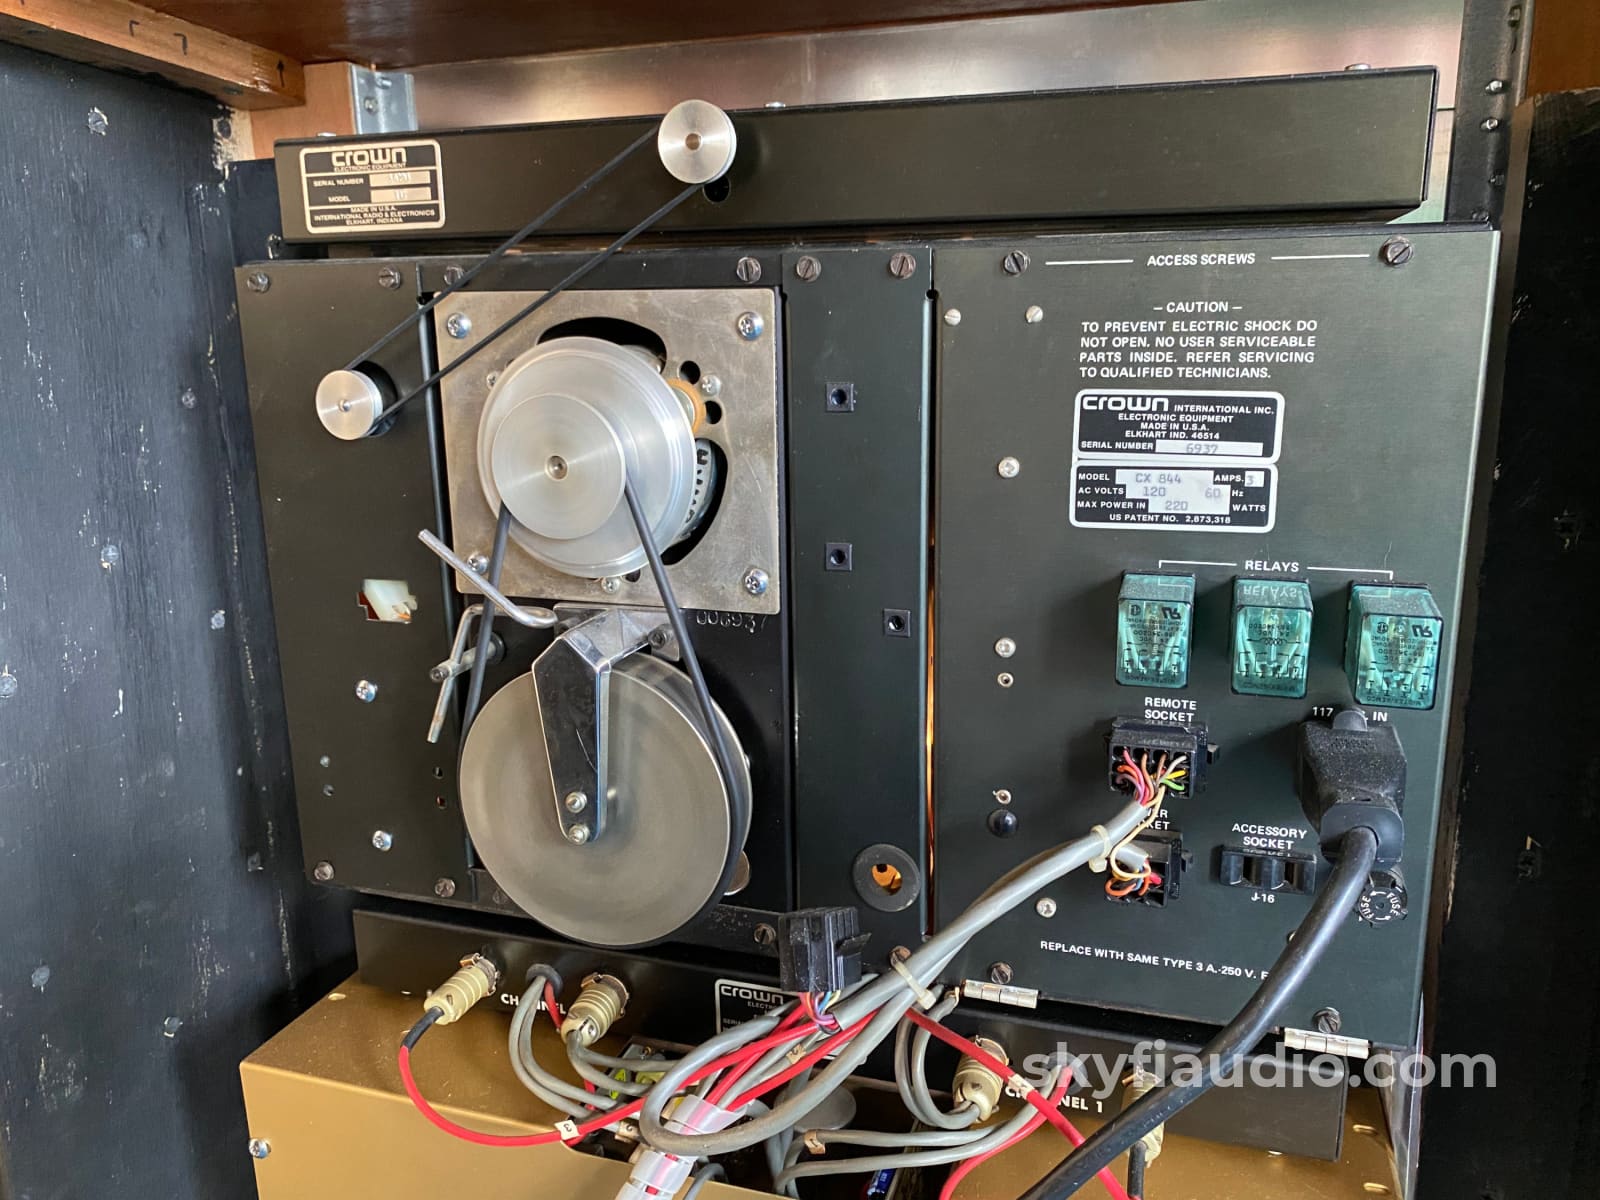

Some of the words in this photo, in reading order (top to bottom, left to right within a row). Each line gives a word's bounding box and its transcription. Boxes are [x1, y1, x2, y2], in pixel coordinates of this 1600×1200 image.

[332, 148, 407, 166] crown
[1147, 254, 1198, 267] ACCESS
[1201, 253, 1255, 265] SCREWS
[1081, 322, 1099, 333] TO
[1104, 321, 1166, 333] PREVENT
[1172, 321, 1239, 332] ELECTRIC
[1244, 320, 1292, 332] SHOCK
[1296, 320, 1318, 331] DO
[1080, 336, 1108, 348] NOT
[1112, 336, 1150, 348] OPEN.
[1155, 336, 1174, 348] NO
[1179, 336, 1214, 348] USER
[1219, 336, 1316, 348] SERVICEABLE
[1079, 352, 1122, 363] PARTS
[1129, 352, 1177, 363] INSIDE.
[1186, 352, 1231, 363] REFER
[1238, 351, 1314, 363] SERVICING
[1079, 367, 1097, 378] TO
[1100, 367, 1173, 378] QUALIFIED
[1177, 367, 1271, 379] TECHNICIANS.
[1082, 396, 1169, 411] crown
[1174, 405, 1252, 414] INTERNATIONAL
[1254, 406, 1274, 414] INC.
[1118, 413, 1177, 421] ELECTRONIC
[1115, 442, 1153, 450] NUMBER
[1186, 443, 1219, 454] 6937
[1135, 473, 1153, 483] CX
[1158, 474, 1182, 484] 844
[1142, 486, 1167, 496] 120
[1205, 488, 1221, 499] 60
[1165, 501, 1188, 511] 220
[1245, 560, 1300, 573] RELAYS
[1144, 697, 1197, 710] REMOTE
[1144, 709, 1194, 722] SOCKET
[1312, 706, 1334, 717] 117
[1373, 712, 1388, 722] IN
[1232, 823, 1307, 839] ACCESSORY
[1243, 836, 1294, 850] SOCKET
[1251, 894, 1275, 904] J-16
[1386, 892, 1401, 916] FUSE
[1361, 896, 1374, 919] FUSE
[1041, 940, 1092, 956] REPLACE
[1095, 948, 1124, 960] WITH
[1127, 952, 1160, 966] SAME
[1163, 958, 1193, 970] TYPE
[1196, 962, 1203, 971] 3
[1245, 969, 1257, 979] V.
[721, 986, 783, 1005] crown
[1096, 1101, 1103, 1112] 1
